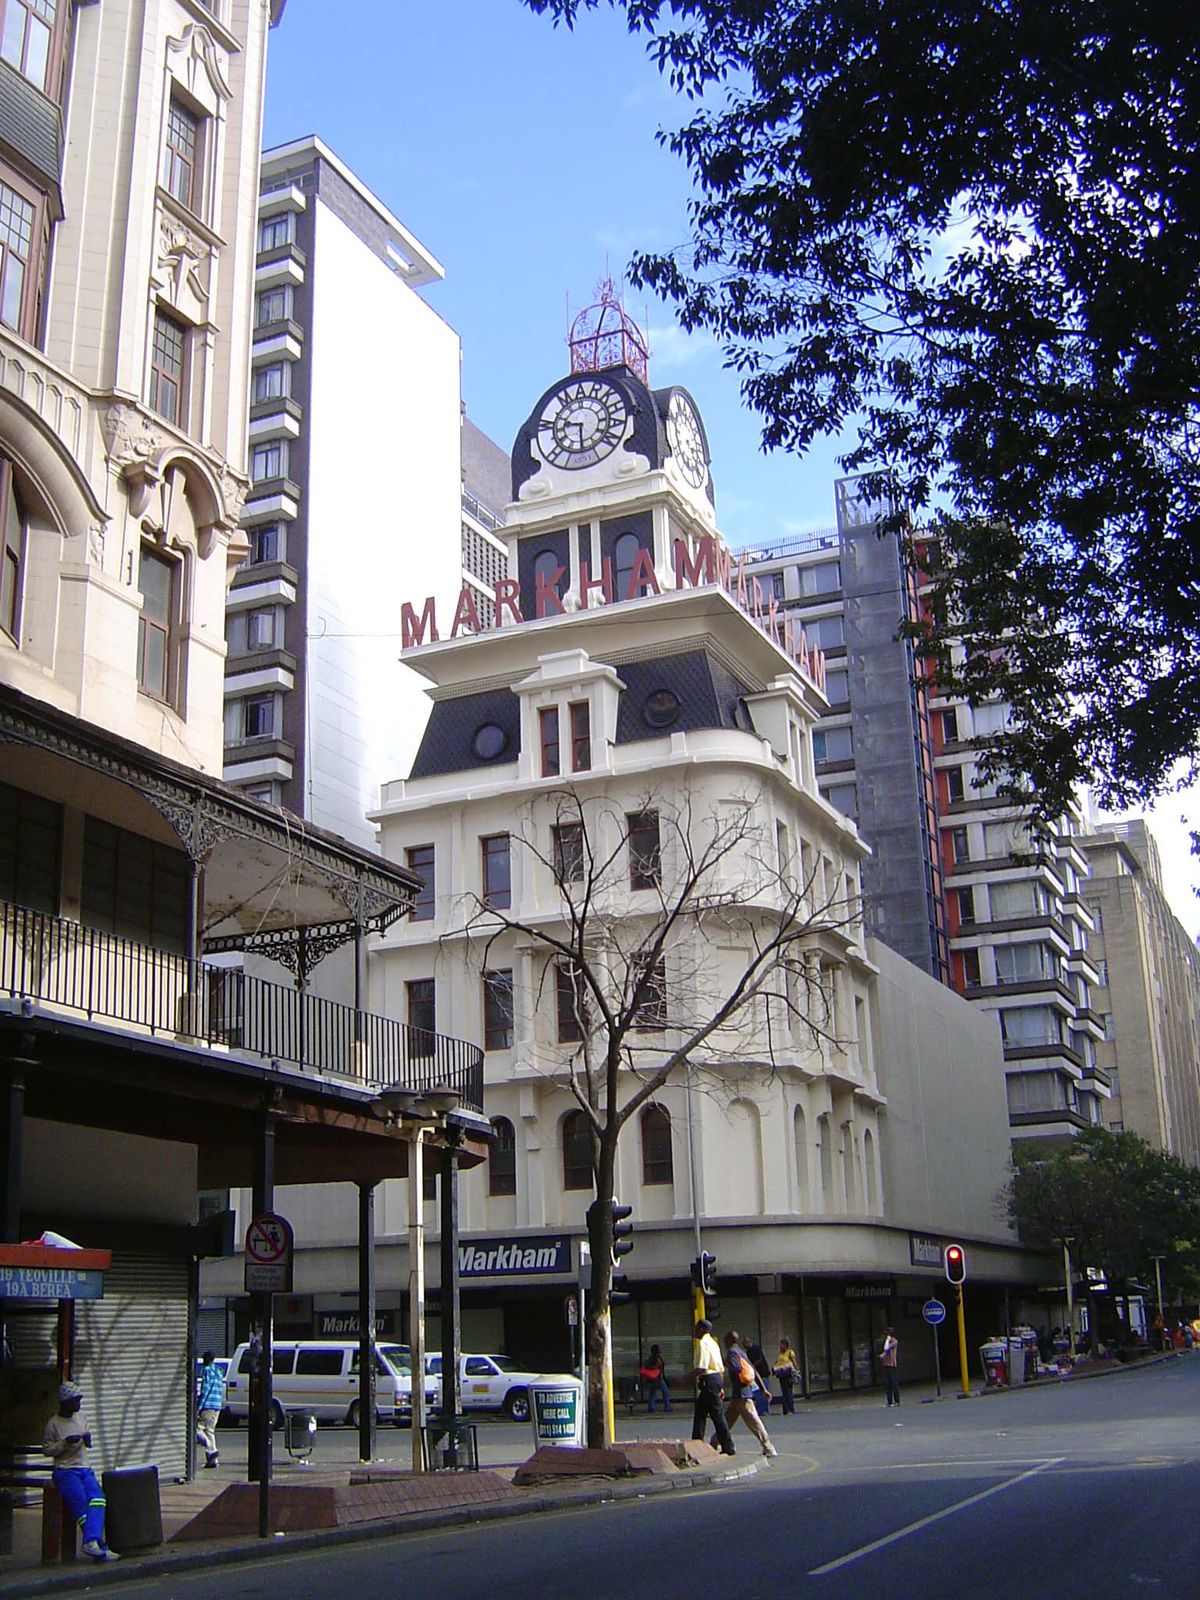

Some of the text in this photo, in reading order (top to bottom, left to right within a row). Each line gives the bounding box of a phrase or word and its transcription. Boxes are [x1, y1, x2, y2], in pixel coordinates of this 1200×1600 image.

[401, 536, 717, 648] MARKHAM
[715, 538, 826, 692] MARKHAM
[459, 1244, 557, 1271] Markham
[19, 1269, 76, 1284] YEOVILLE
[7, 1281, 72, 1298] 19A BEREA
[844, 1287, 891, 1297] Markham
[557, 1408, 570, 1419] CALL
